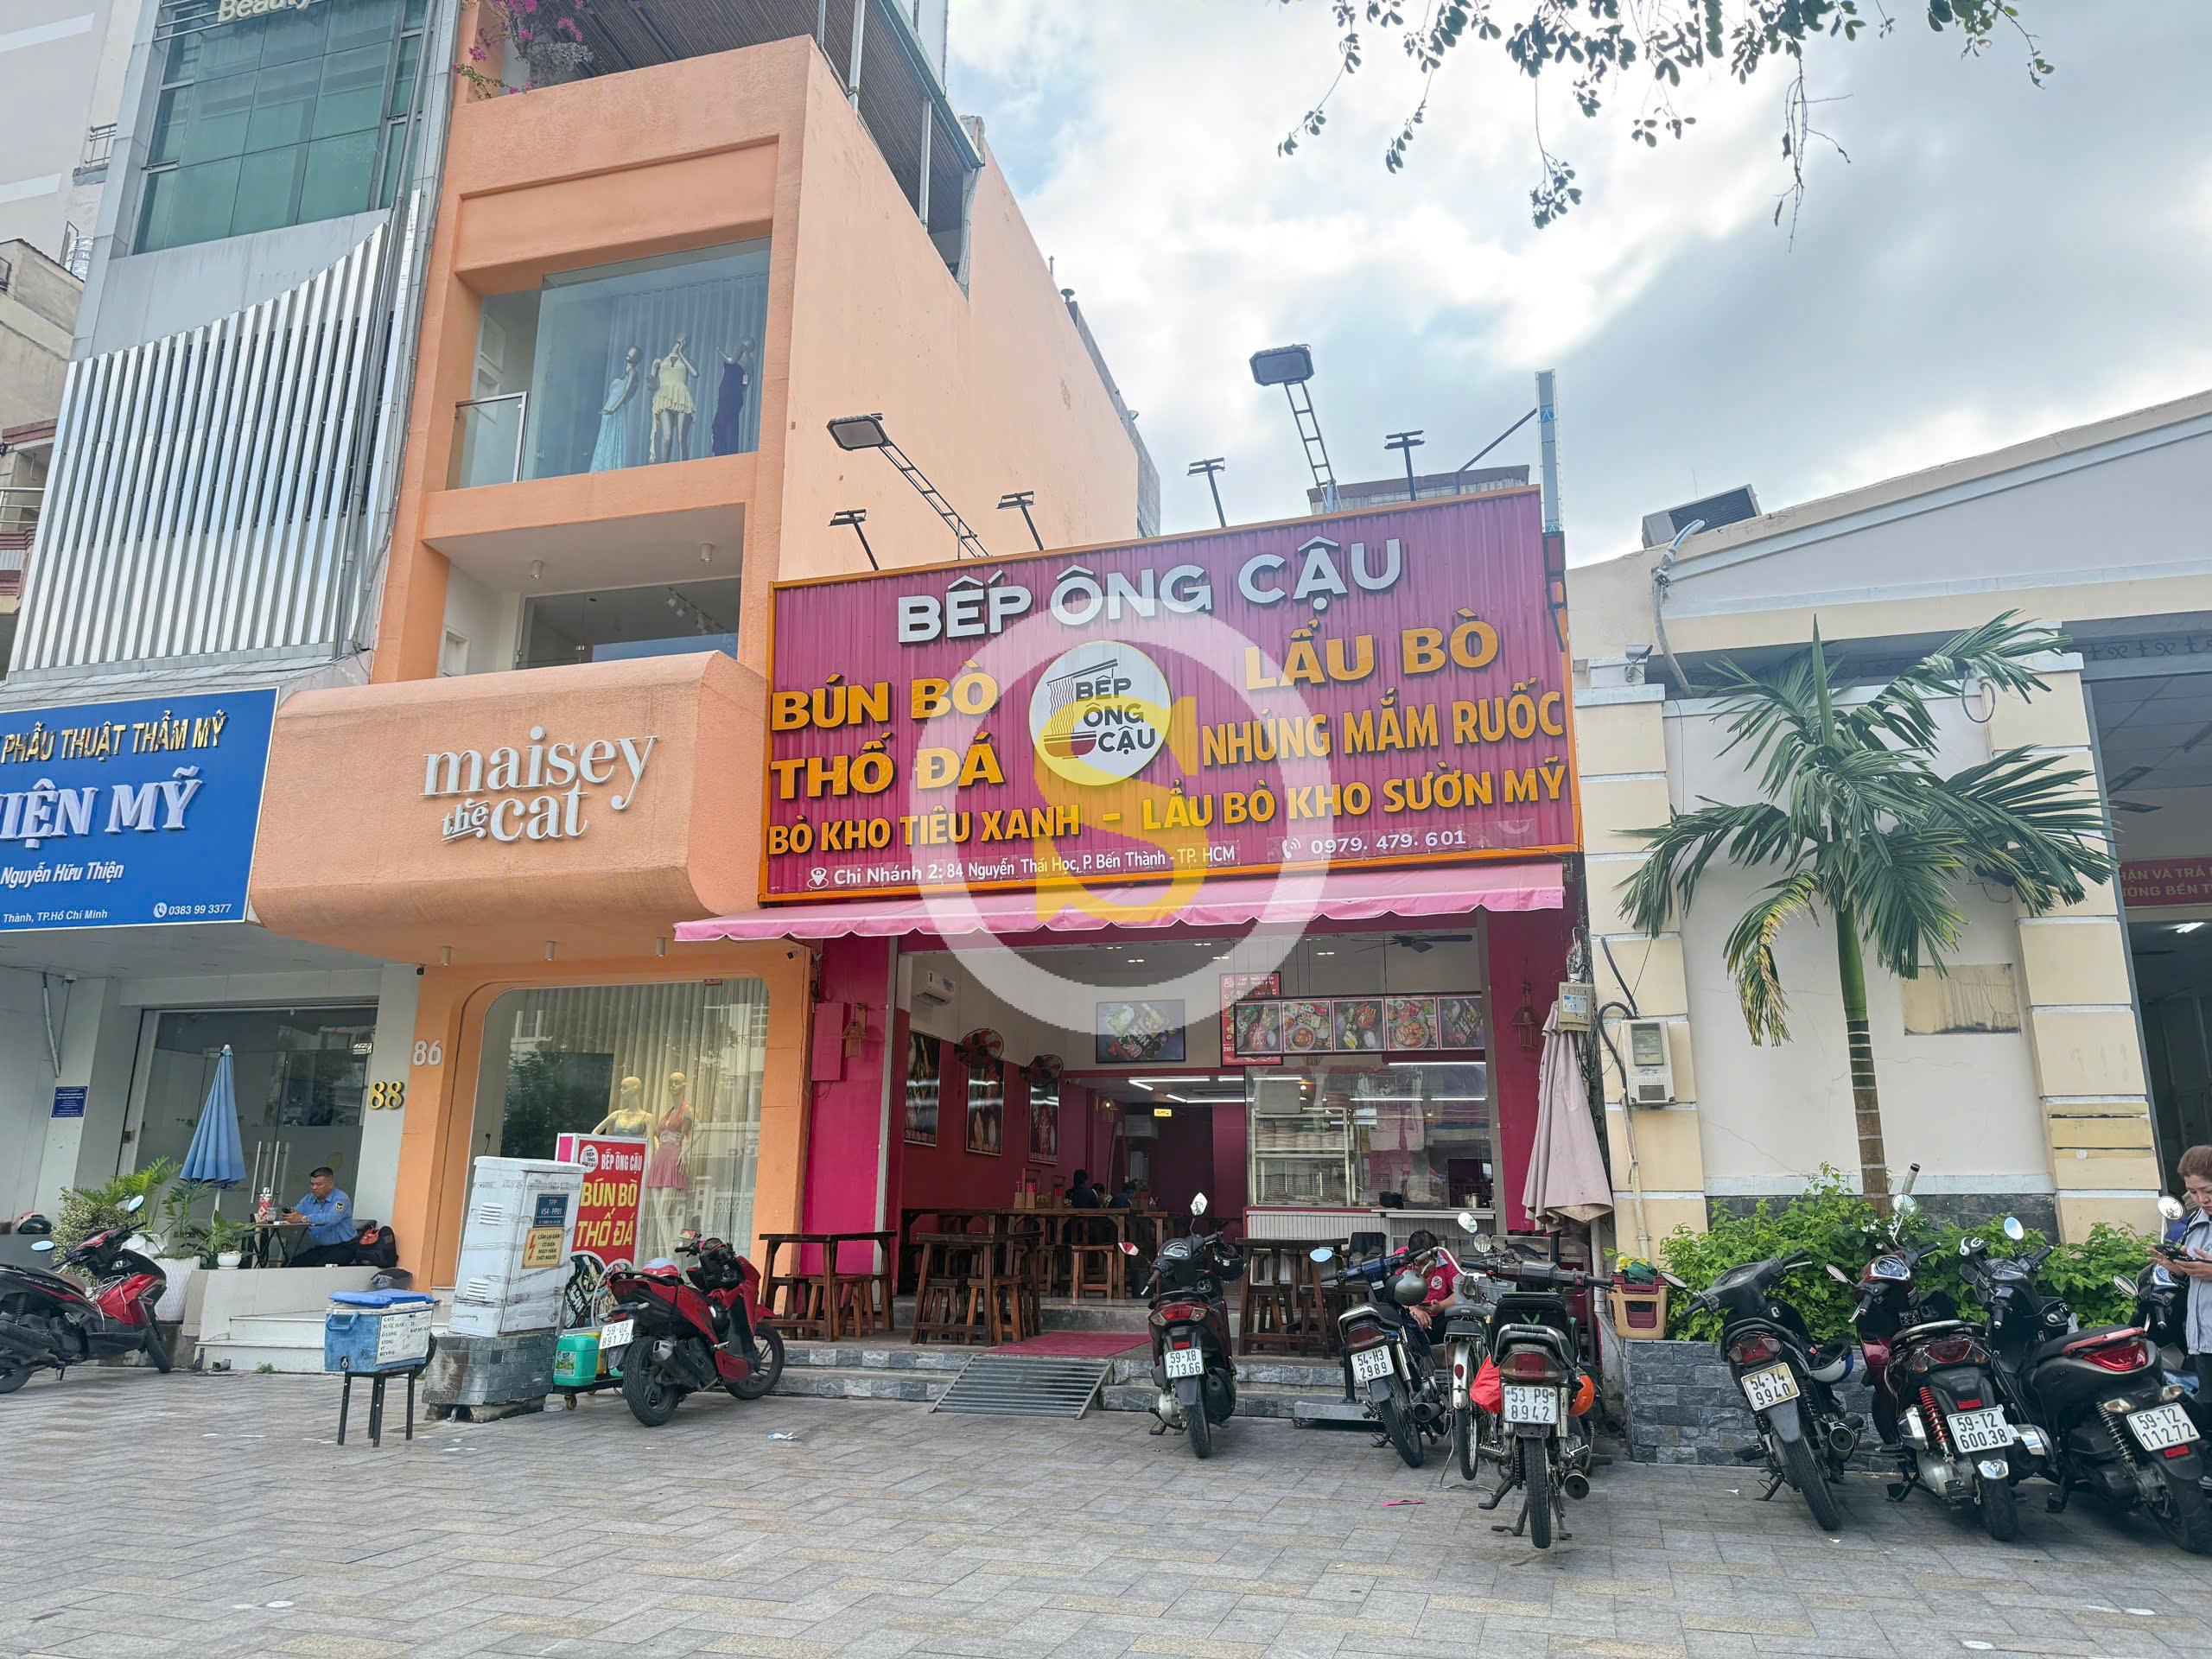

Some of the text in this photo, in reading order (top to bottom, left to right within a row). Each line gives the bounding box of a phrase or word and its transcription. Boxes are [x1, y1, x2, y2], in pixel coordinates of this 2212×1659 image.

[218, 0, 309, 22] Beau
[898, 536, 1402, 643] BẾP ÔNG CẬU
[1244, 607, 1499, 690] LẨU BÒ
[772, 659, 999, 731] BÚN BÒ
[1076, 670, 1155, 754] BẾP ÔNG CẬU
[1202, 677, 1564, 766] NHÚNG MẮM RUỐC
[1, 709, 229, 764] PHẪU THUẬT THẨM MỸ
[419, 726, 659, 810] maisey
[771, 731, 1005, 799] THỐ ĐÁ
[0, 765, 203, 849] IỆN MỸ
[442, 779, 592, 842] the cat
[769, 814, 814, 855] BÒ
[821, 817, 892, 852] KHO
[899, 804, 971, 845] TIÊU
[981, 804, 1079, 842] XANH
[1142, 779, 1213, 830] LẨU
[1223, 779, 1276, 824] BÒ
[1287, 782, 1372, 820] KHO
[1382, 761, 1493, 813] SƯỜN
[1503, 755, 1566, 804] MỸ
[1311, 830, 1466, 855] 0979. 479. 601
[0, 861, 125, 889] Nguyễn Hữu Thiện
[834, 868, 862, 885] Chi
[867, 865, 922, 883] Nhánh
[927, 863, 944, 880] 2:
[947, 862, 963, 878] 84
[968, 858, 1015, 880] Nguyễn
[1020, 857, 1047, 873] Thái
[1052, 855, 1079, 876] Học,
[1083, 855, 1092, 870] P.
[1096, 850, 1121, 868] Bến
[1125, 850, 1166, 868] Thành
[1177, 848, 1197, 863] TP.
[1202, 846, 1235, 862] HCM
[2152, 867, 2172, 879] VÀ
[2165, 882, 2197, 895] BẾN
[3, 909, 108, 924] Thành, TP.Hồ Chí Minh
[168, 903, 232, 915] 0383 99 3377
[413, 1039, 442, 1066] 86
[370, 1080, 403, 1109] 88
[601, 1147, 643, 1173] BẾP ÔNG CẬU
[580, 1178, 638, 1207] BÚN BÒ
[575, 1207, 635, 1247] THỐ ĐÁ
[1168, 1362, 1201, 1377] 713.66
[1170, 1350, 1197, 1363] 59-XB
[1360, 1362, 1388, 1379] 2989
[1755, 1382, 1790, 1406] 9940
[1511, 1404, 1550, 1421] 8942
[1956, 1412, 1998, 1433] 59-T2
[2137, 1408, 2181, 1430] 59-T2
[1960, 1428, 2008, 1450] 600.38
[2142, 1422, 2196, 1447] 112.72
